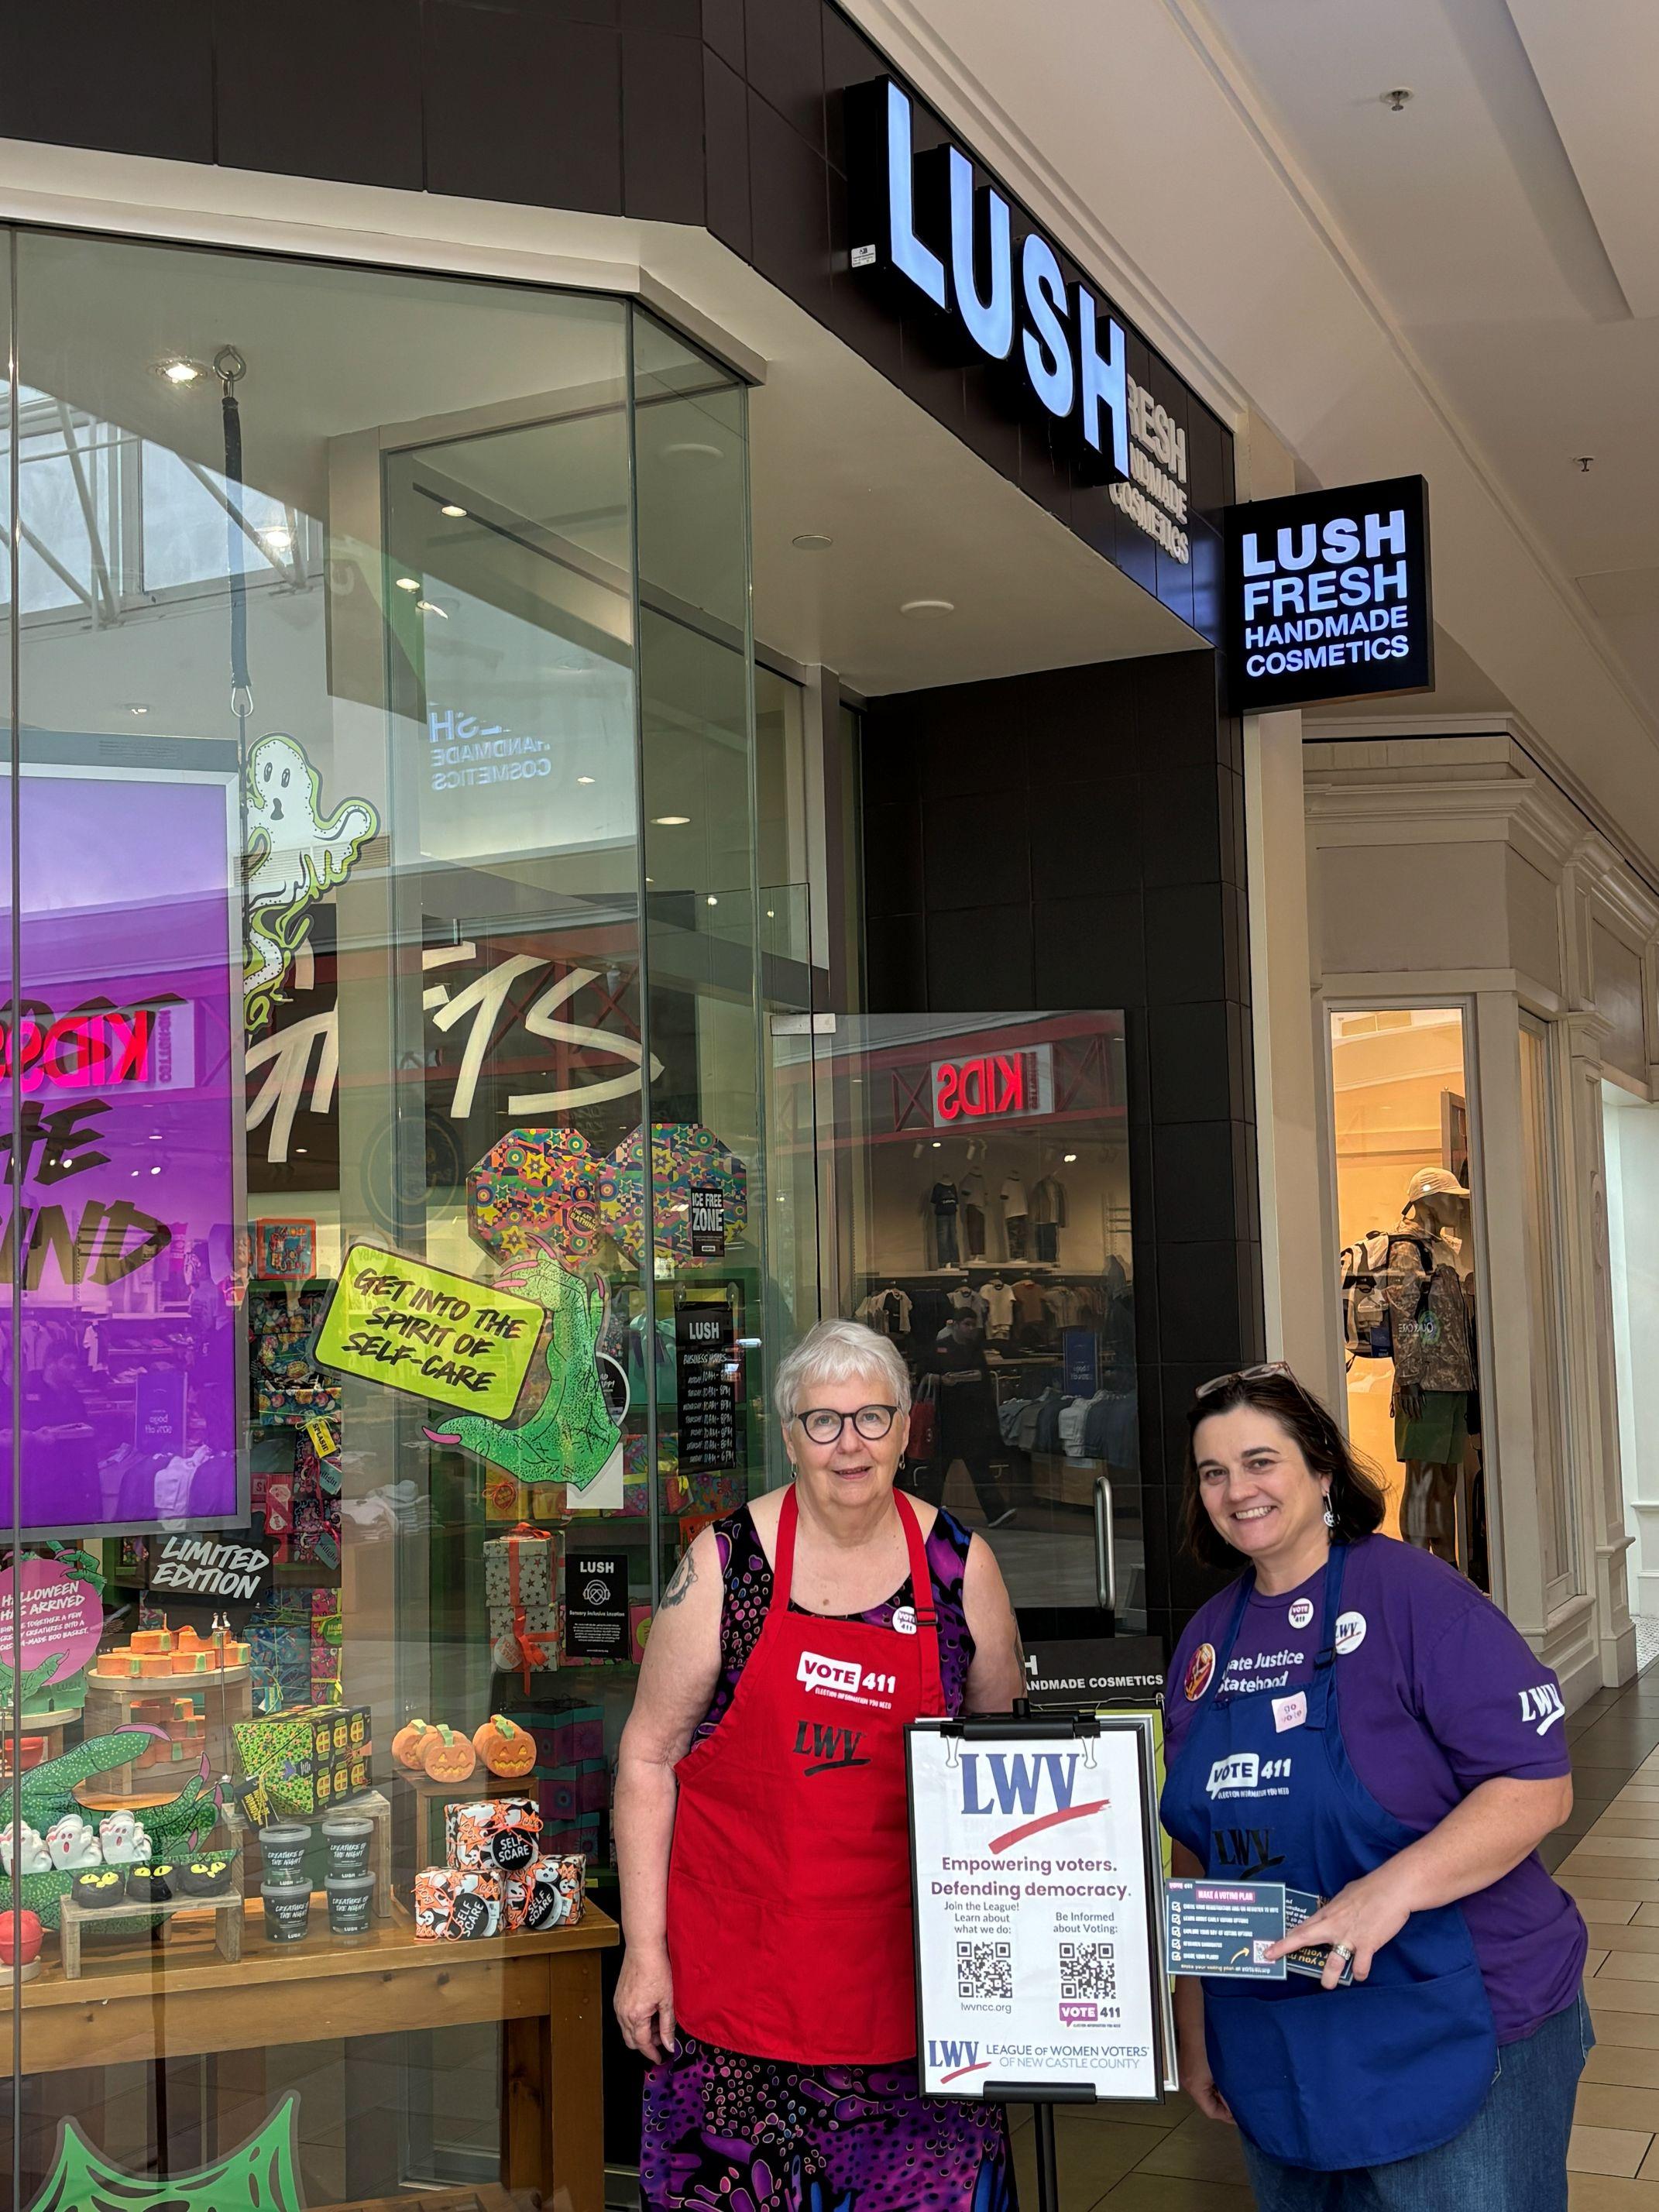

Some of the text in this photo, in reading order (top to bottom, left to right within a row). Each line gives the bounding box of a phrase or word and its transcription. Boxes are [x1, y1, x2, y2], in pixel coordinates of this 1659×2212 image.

[888, 80, 1129, 479] LUSH
[1242, 510, 1406, 577] LUSH
[1244, 560, 1407, 620] FRESH
[1245, 605, 1408, 649] HANDMADE
[1246, 634, 1409, 677] COSMETICS
[692, 1193, 722, 1207] ICE FREE
[692, 1209, 723, 1231] ZONE
[354, 1268, 528, 1338] GET INTO THE
[366, 1306, 496, 1358] SPIRIT OF
[689, 1322, 720, 1339] LUSH
[342, 1332, 496, 1392] SELF-CARE
[160, 1537, 270, 1573] LIMITED
[580, 1561, 614, 1574] LUSH
[152, 1561, 261, 1599] EDITION
[2, 1581, 79, 1607] HLLOWEEN
[0, 1595, 85, 1621] HS ARRIVED
[1292, 1604, 1309, 1614] VOTE
[901, 1623, 912, 1632] 411
[1255, 1649, 1304, 1669] Justice
[804, 1660, 895, 1694] VOTE 411
[1089, 1674, 1163, 1688] COSMETICS
[1284, 1704, 1297, 1713] go
[793, 1720, 862, 1762] LWV
[1214, 1758, 1292, 1783] VOTE 411
[959, 1753, 1080, 1815] LWV
[498, 1845, 530, 1863] SCARE
[500, 1836, 522, 1850] SELF
[942, 1856, 1118, 1876] Empowering voters.
[527, 1889, 545, 1914] SELF
[931, 1881, 1132, 1901] Defending democracy.
[455, 1900, 472, 1926] SELF
[528, 1894, 553, 1925] SCARE
[944, 1901, 1019, 1912] Join the League!
[1056, 1912, 1115, 1922] Be Informed
[462, 1901, 484, 1937] SCARE
[955, 1914, 1010, 1922] Learn about
[954, 1925, 979, 1934] what
[996, 1925, 1012, 1934] do:
[1053, 1924, 1118, 1935] about Voting:
[961, 2002, 1012, 2014] lwvncc.org
[1062, 2008, 1121, 2018] VOTE 411
[928, 2040, 979, 2067] LWV
[986, 2045, 1032, 2056] LEAGUE
[1049, 2046, 1099, 2056] WOMEN
[1000, 2057, 1140, 2069] OF NEW CASTLE COUNTY
